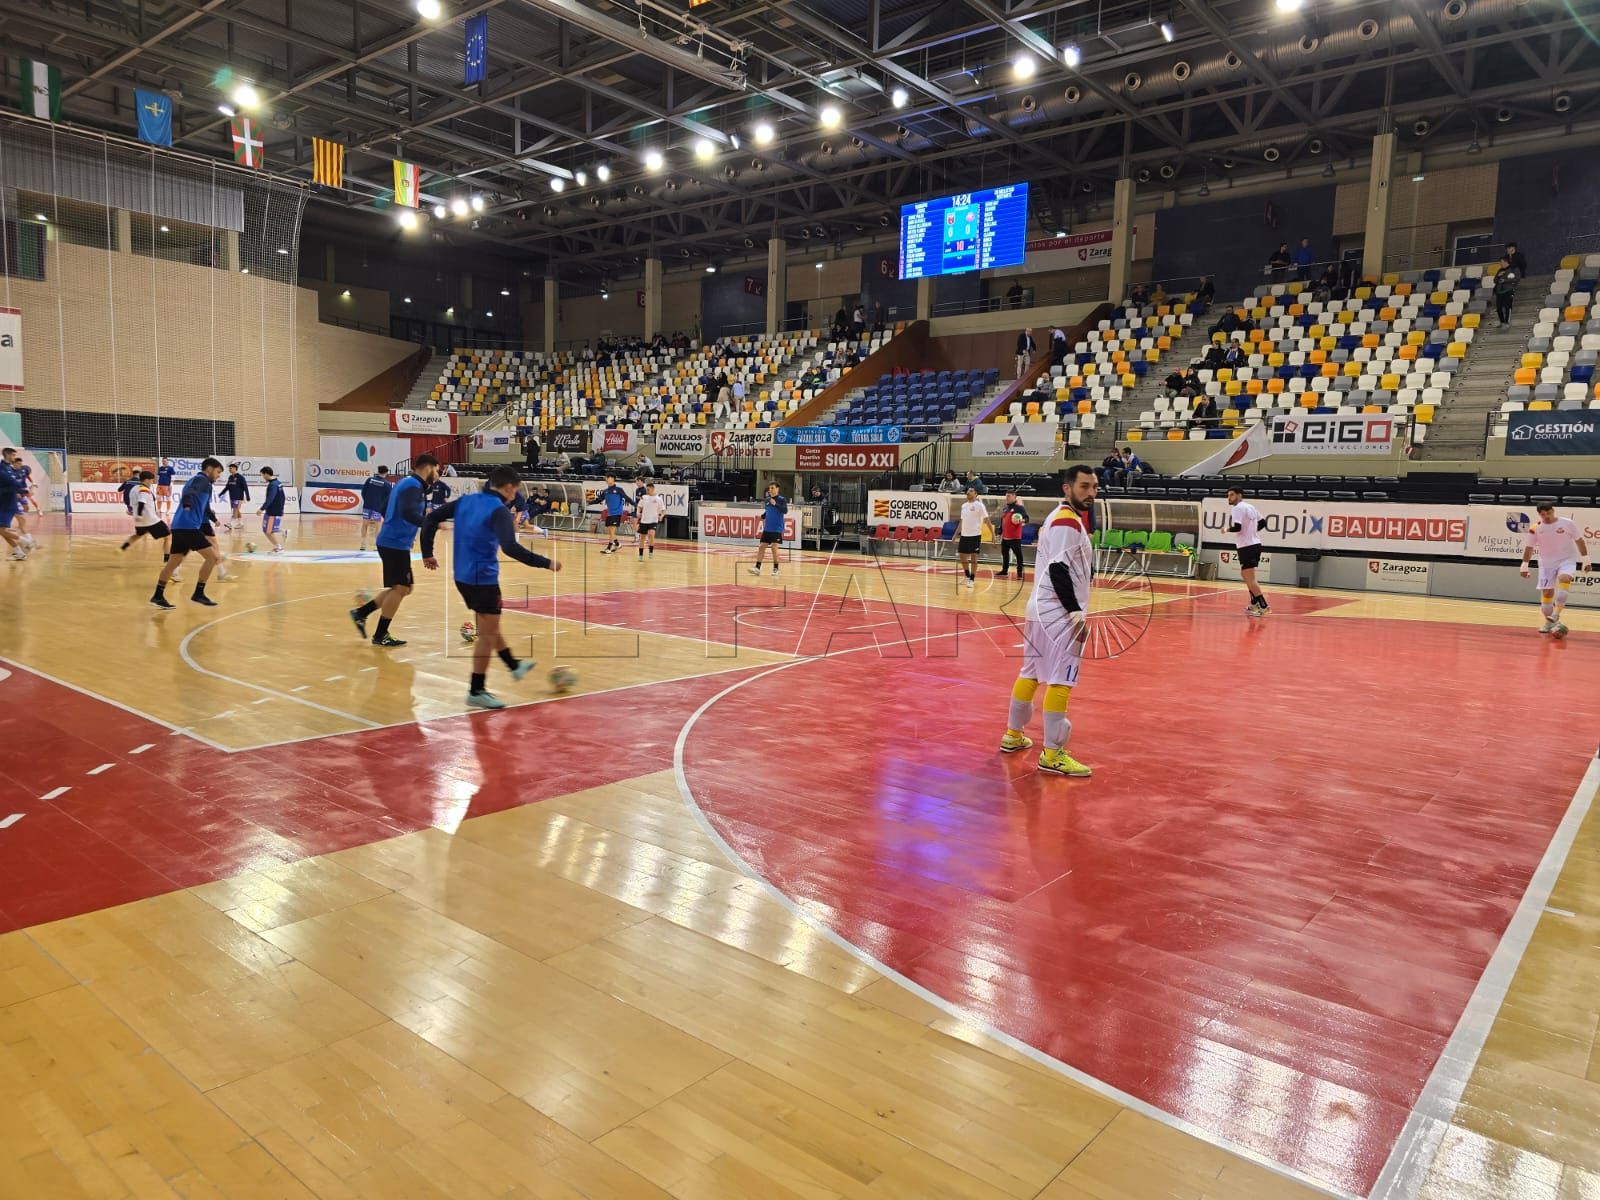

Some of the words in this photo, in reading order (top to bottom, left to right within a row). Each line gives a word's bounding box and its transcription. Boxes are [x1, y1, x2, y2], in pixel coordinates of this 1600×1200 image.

[952, 193, 971, 206] 14:24
[881, 260, 888, 275] 6
[746, 278, 754, 292] 7
[411, 414, 442, 423] Zaragoza
[1534, 421, 1594, 433] GESTIÓN
[729, 431, 772, 445] Zaragoza
[660, 442, 702, 452] MONCAYO
[726, 446, 771, 456] DEPORTE
[825, 453, 866, 467] SIGLO
[870, 453, 894, 467] XXI
[324, 468, 371, 477] ODVENDING
[315, 494, 356, 504] ROMERO
[890, 500, 938, 510] GOBIERNO
[889, 509, 902, 519] DE
[904, 511, 944, 521] ARAGON
[705, 517, 794, 538] BAUHAS
[1329, 518, 1465, 539] BAUHAUS
[1478, 535, 1512, 547] Miguel
[1382, 562, 1428, 575] Zaragoza
